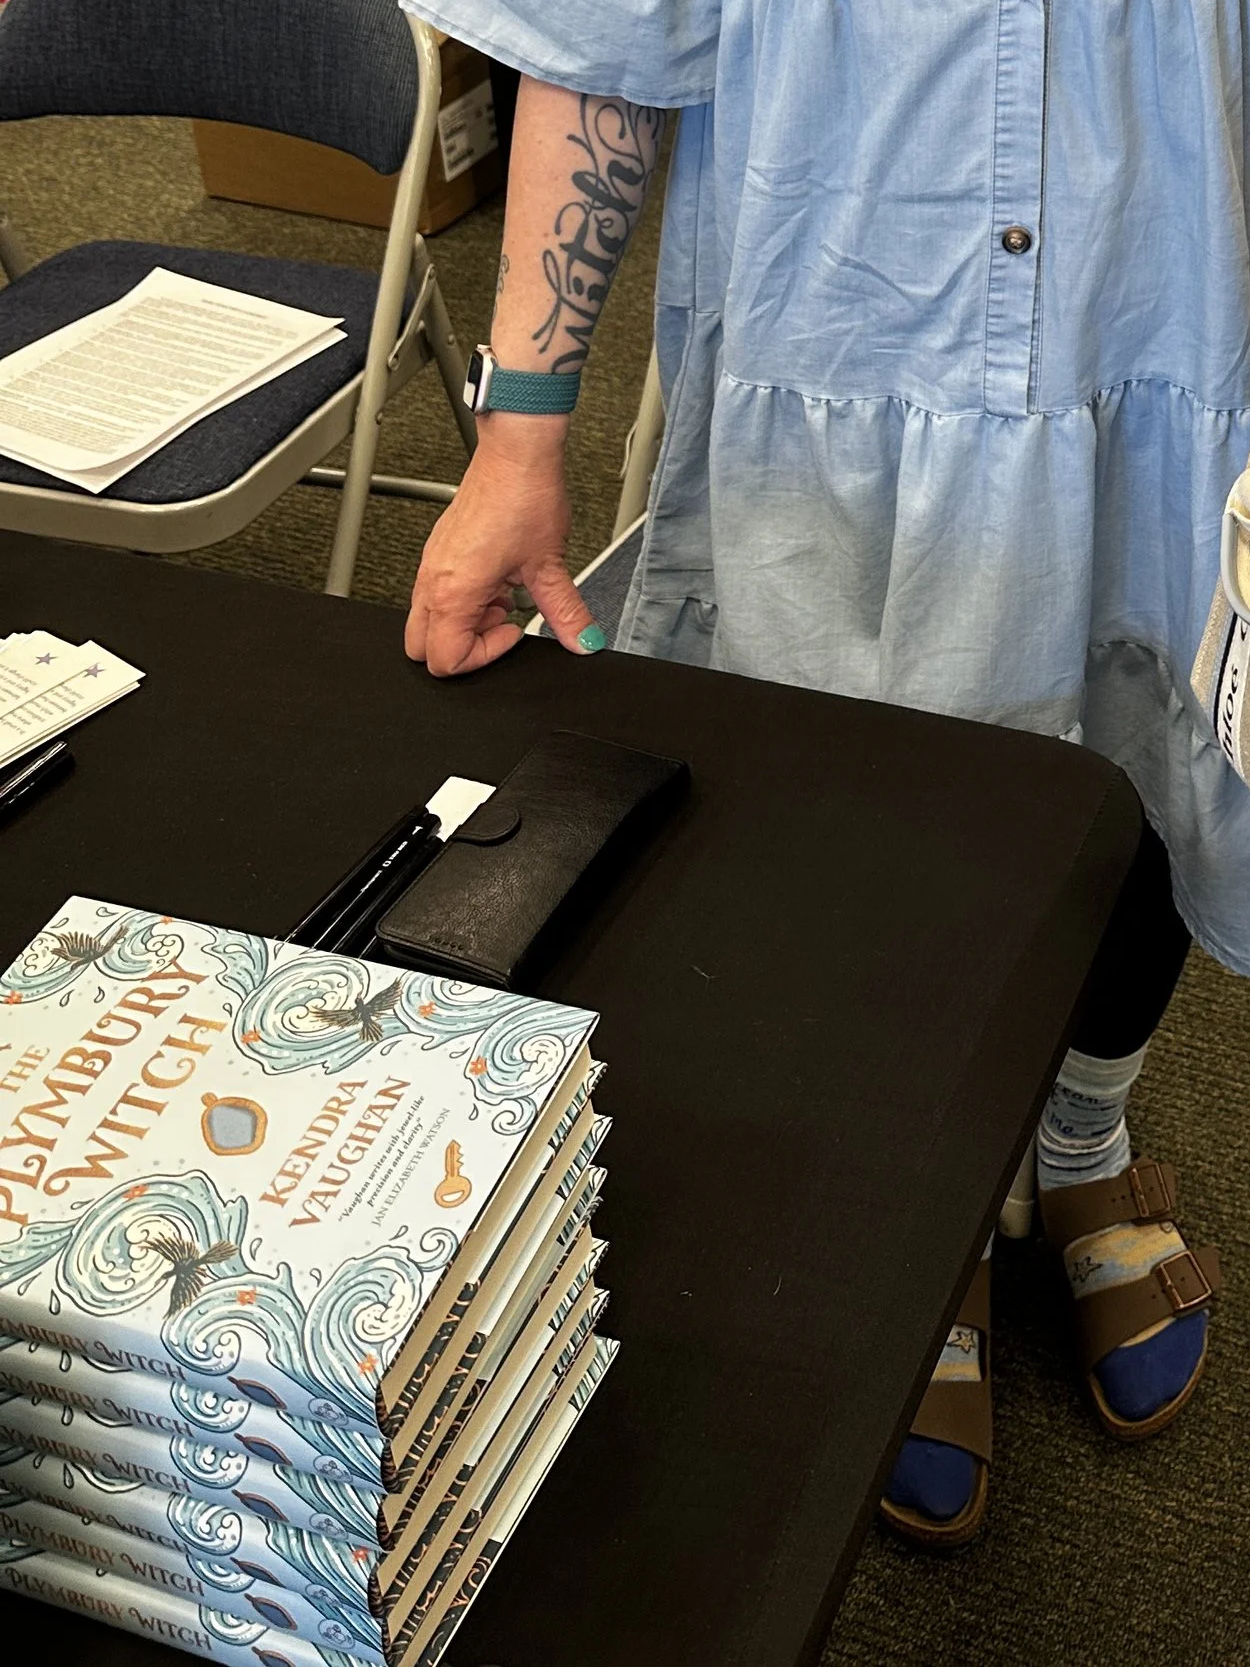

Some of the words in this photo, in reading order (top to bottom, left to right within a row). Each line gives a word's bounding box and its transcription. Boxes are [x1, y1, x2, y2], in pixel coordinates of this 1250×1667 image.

[0, 1044, 50, 1093] THE
[0, 955, 210, 1226] PLYMBURY
[43, 1013, 228, 1197] WITCH
[259, 1080, 368, 1208] KENDRA
[288, 1075, 411, 1228] VAUGHAN
[367, 1168, 394, 1208] precision
[392, 1149, 405, 1168] and
[368, 1155, 388, 1182] writes
[386, 1134, 400, 1155] with
[398, 1095, 425, 1138] jewel-like
[371, 1207, 388, 1228] JAN
[386, 1149, 425, 1209] ELIZABETH
[419, 1107, 451, 1150] WATSON
[94, 1340, 187, 1381] WITCH
[103, 1398, 195, 1438] WITCH
[102, 1453, 192, 1493] WITCH
[5, 1567, 123, 1620] PLYMBURY
[129, 1607, 212, 1651] WITCH
[120, 1553, 205, 1597] WITCH
